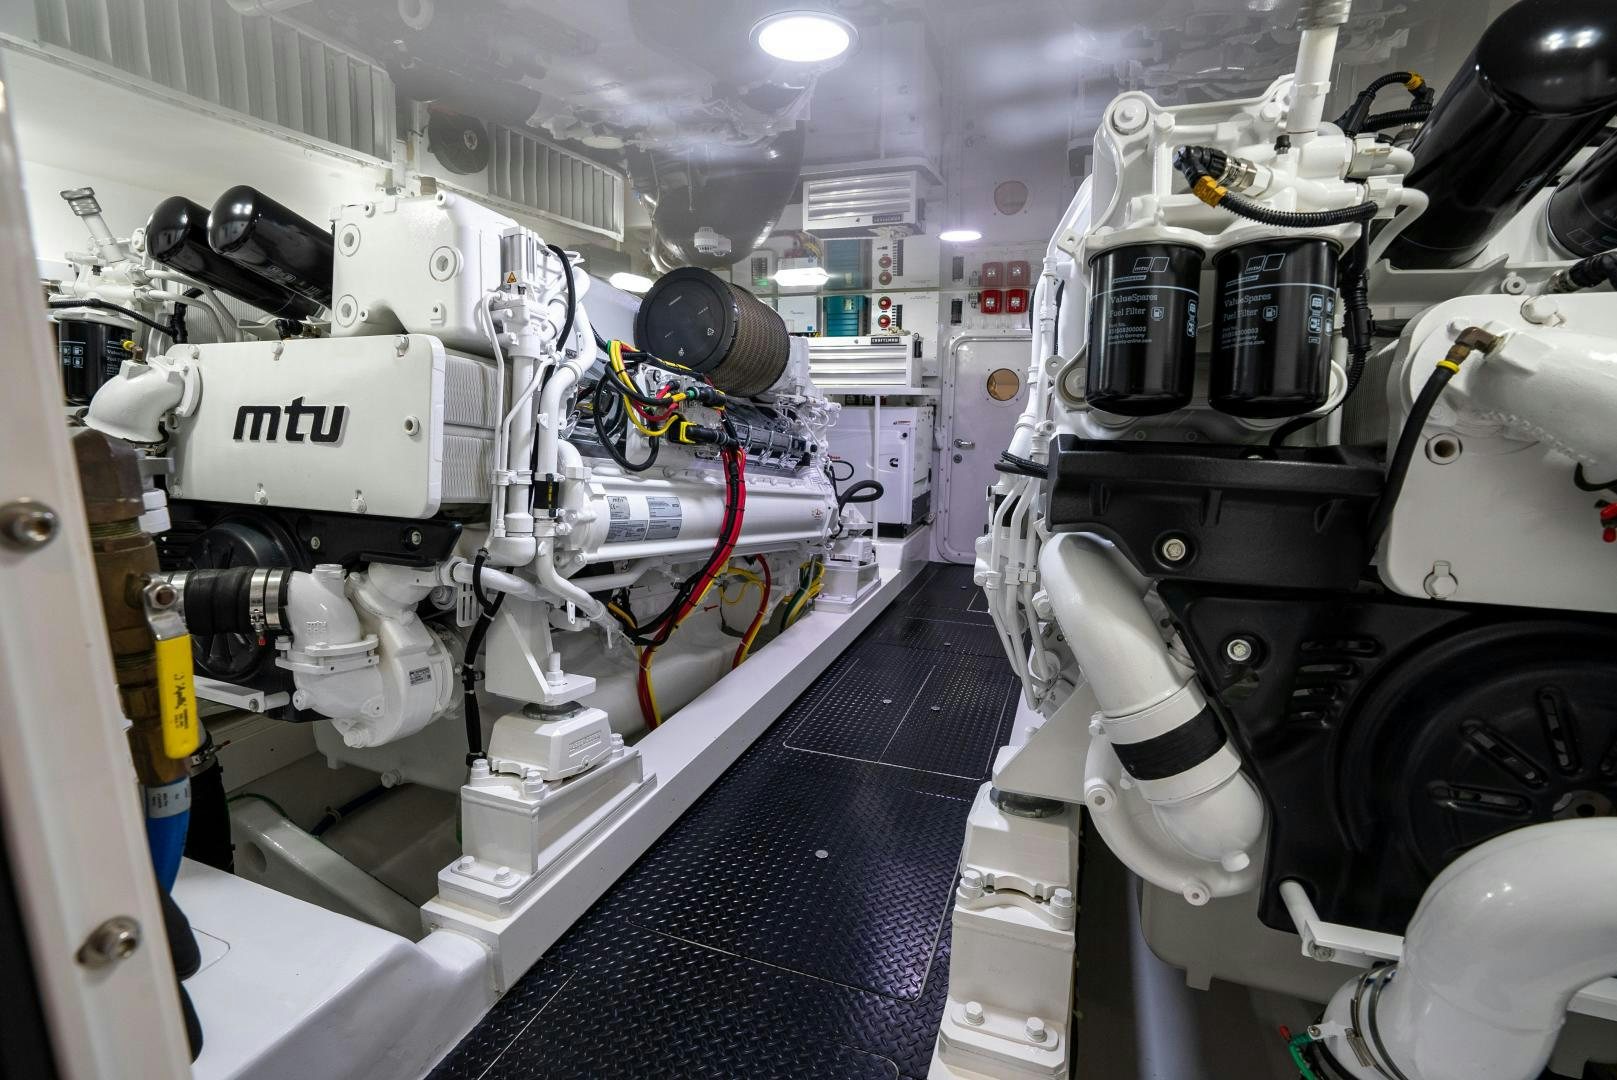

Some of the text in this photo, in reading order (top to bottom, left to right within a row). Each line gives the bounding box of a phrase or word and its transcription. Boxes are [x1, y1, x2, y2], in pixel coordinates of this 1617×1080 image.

[1111, 293, 1158, 303] ValueSpares
[1224, 293, 1272, 307] ValueSpares
[1109, 307, 1146, 317] Fuel Filter
[233, 396, 345, 442] mtu
